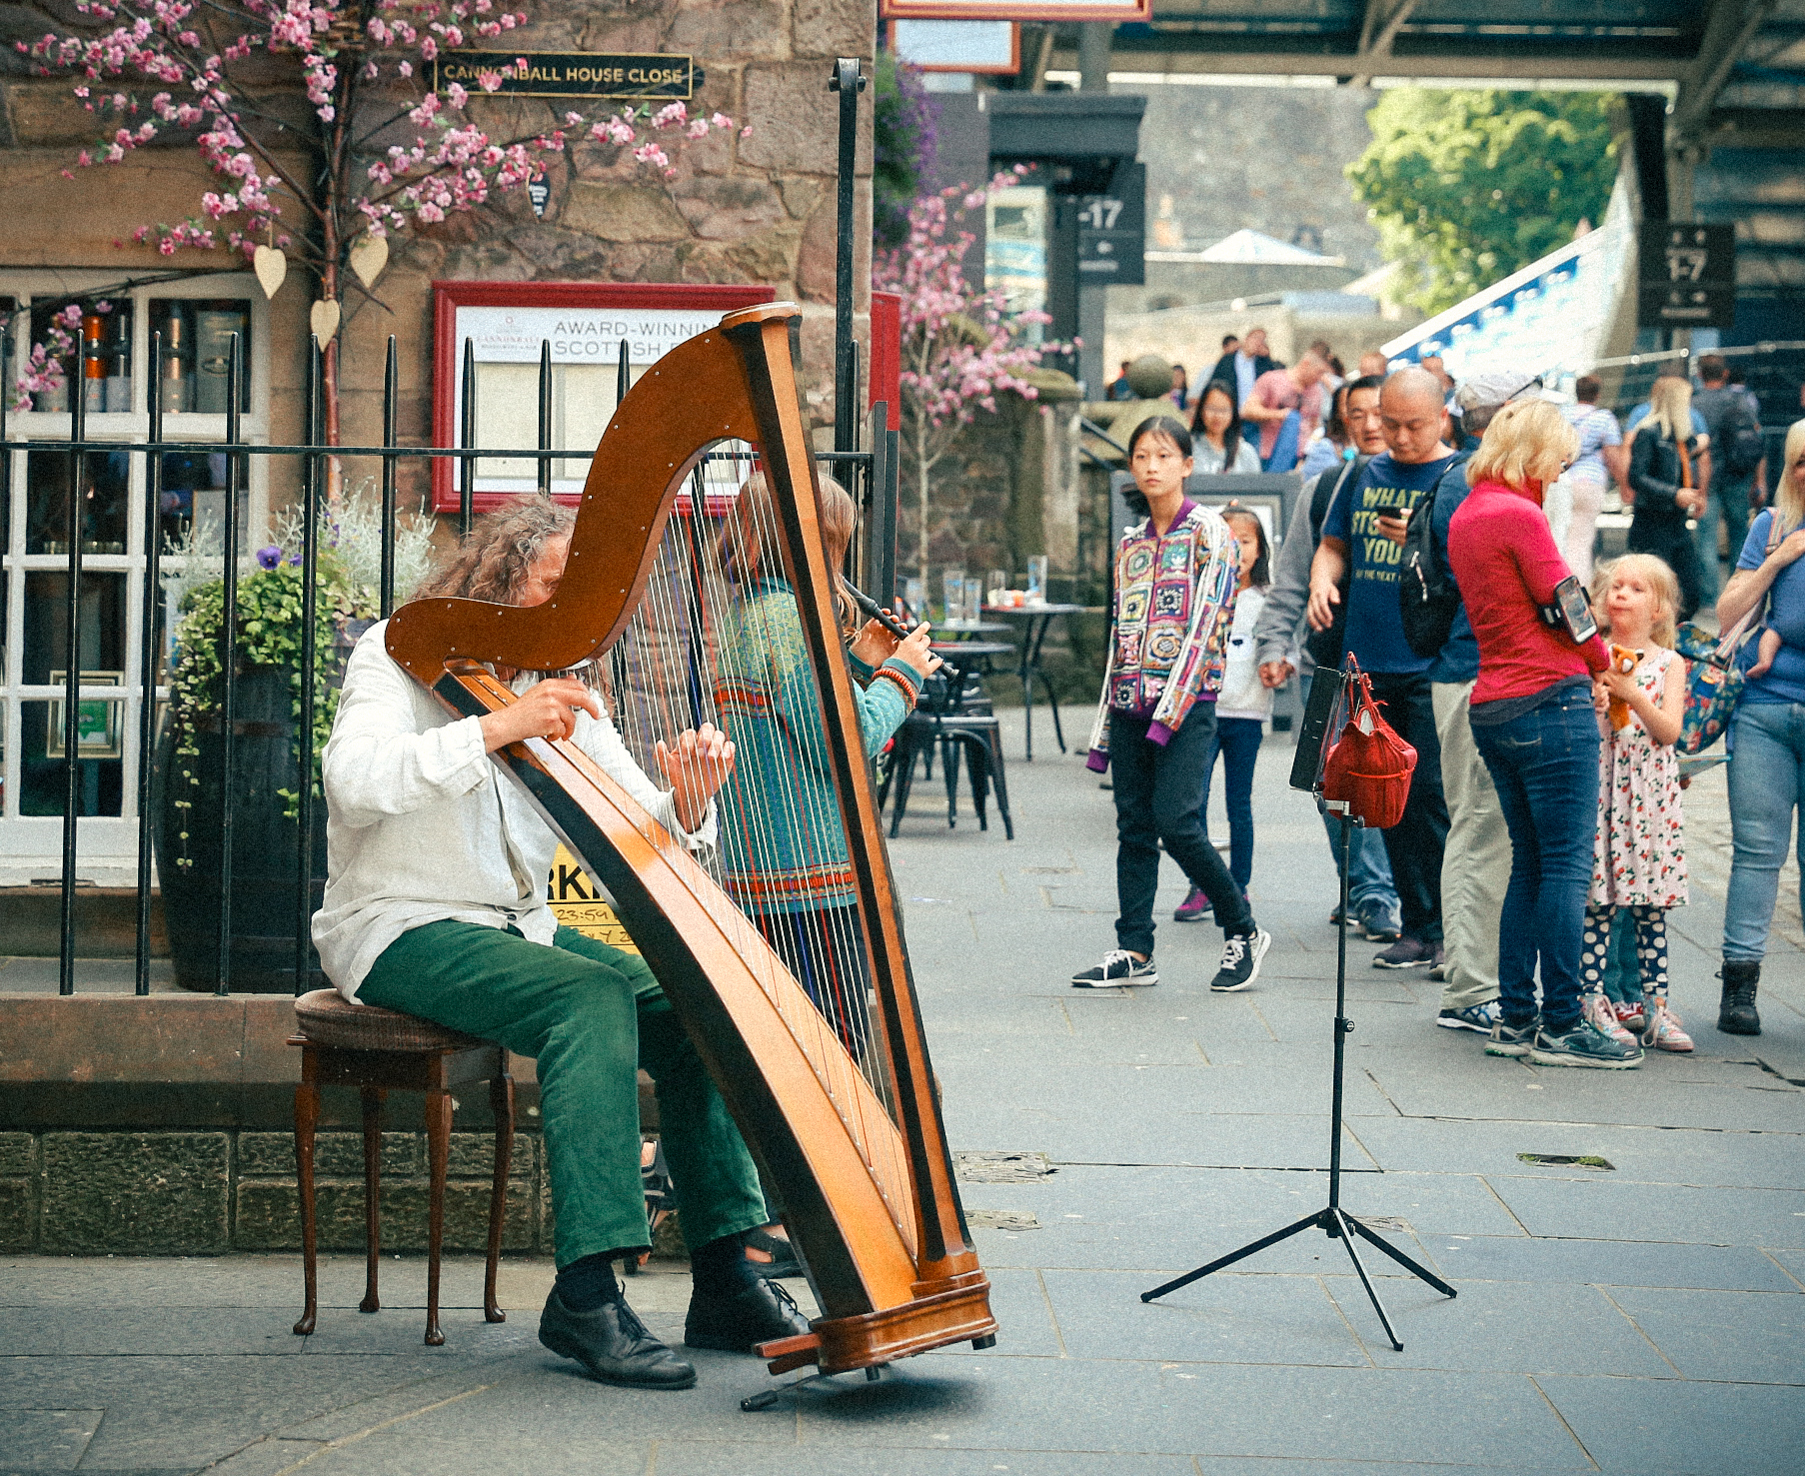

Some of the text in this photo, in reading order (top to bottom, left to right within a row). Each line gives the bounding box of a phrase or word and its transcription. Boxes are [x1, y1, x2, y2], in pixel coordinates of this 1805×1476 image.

[566, 67, 623, 83] HOUSE
[628, 69, 682, 84] CLOSE
[555, 340, 661, 356] SCOTTSH
[1363, 538, 1402, 565] YOU
